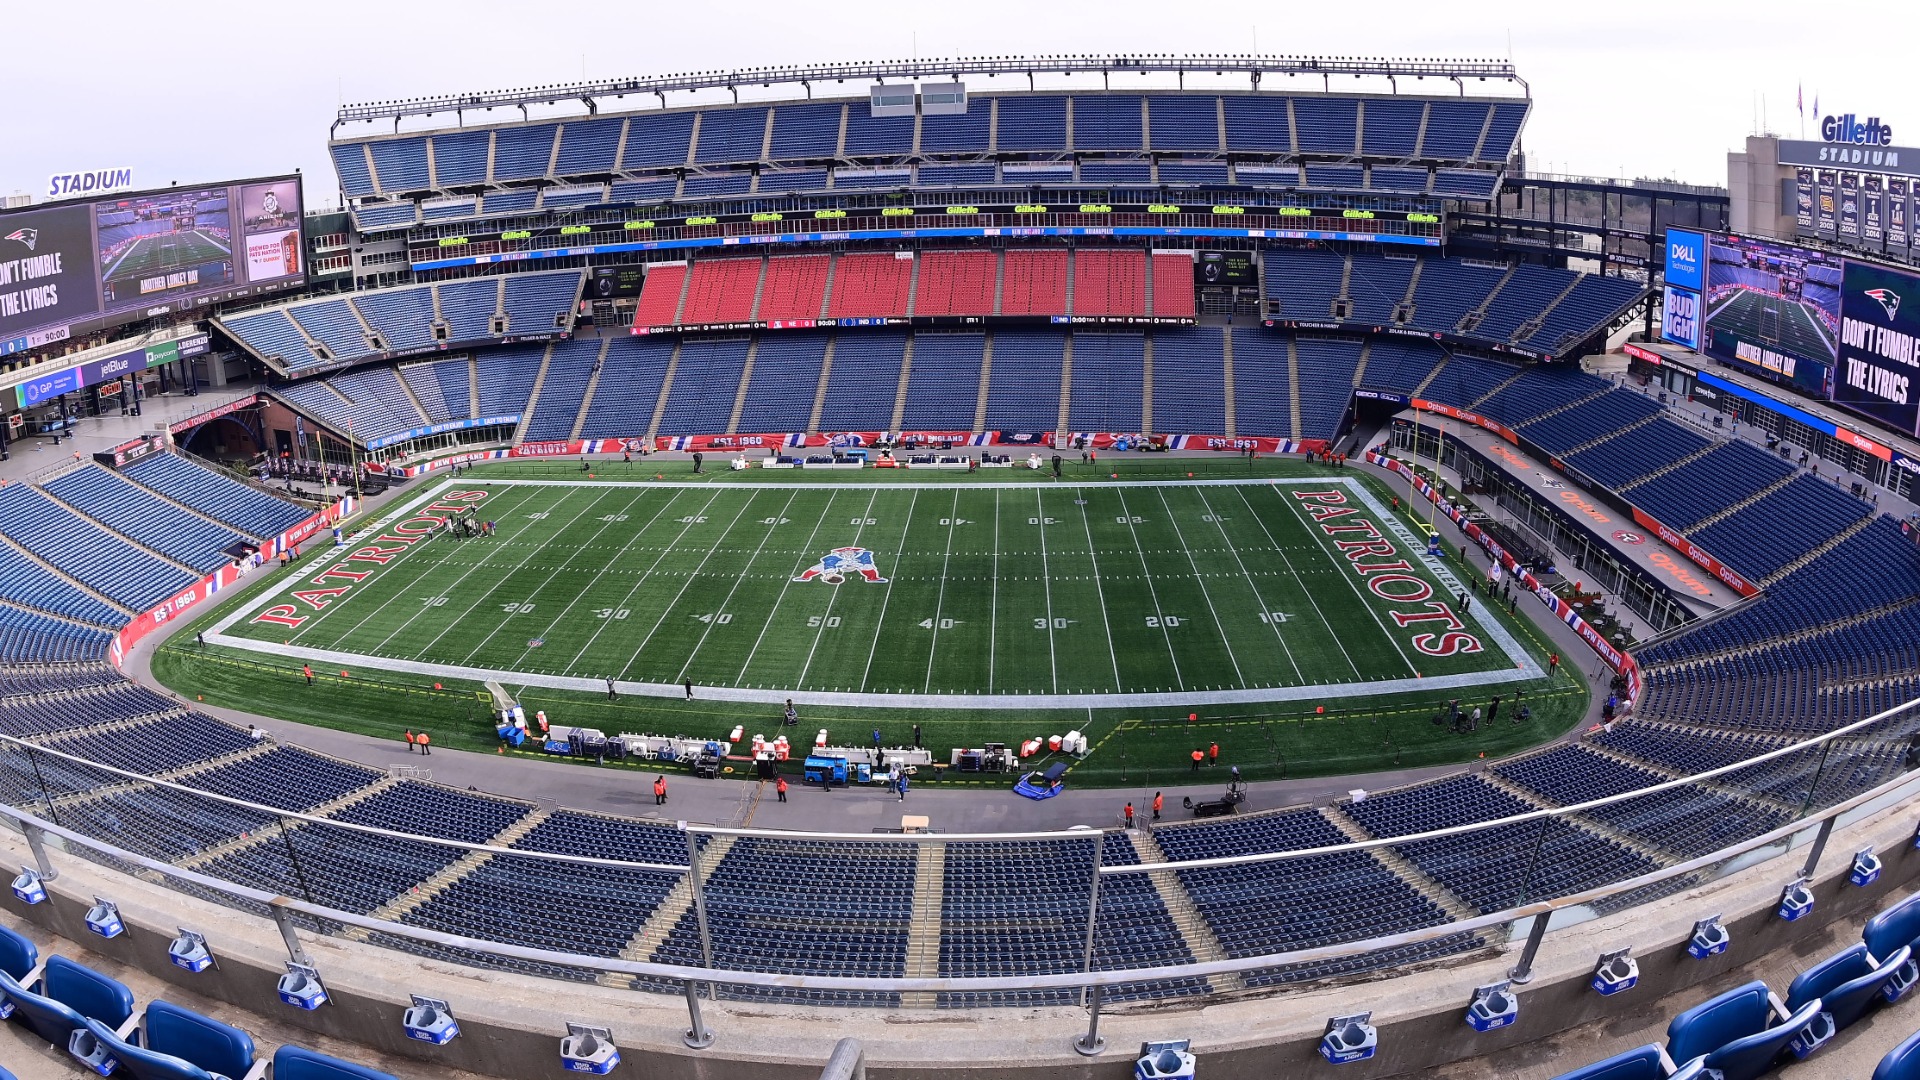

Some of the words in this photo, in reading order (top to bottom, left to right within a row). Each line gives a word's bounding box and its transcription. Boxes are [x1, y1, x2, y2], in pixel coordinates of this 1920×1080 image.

[1821, 114, 1893, 147] Gillette
[1819, 147, 1899, 168] STADIUM
[50, 168, 131, 196] STADIUM
[815, 209, 846, 219] Gillette
[882, 207, 914, 217] Gillette
[946, 205, 978, 215] Gillette
[1014, 205, 1047, 214] Gillette
[1079, 204, 1111, 214] Gillette
[1147, 205, 1180, 214] Gillette
[1213, 205, 1244, 215] Gillette
[1279, 207, 1311, 217] Gillette
[1343, 209, 1374, 219] Gillette
[686, 216, 717, 225] Gillette
[751, 212, 783, 222] Gillette
[1407, 213, 1438, 223] Gillette
[561, 224, 591, 235] Gillette
[624, 220, 655, 230] Gillette
[1819, 221, 1834, 230] 2003
[501, 230, 531, 240] Gillette
[1866, 229, 1880, 238] 2014
[438, 236, 468, 247] Gillette
[1672, 244, 1696, 263] DELL
[0, 259, 20, 286] ON'T
[21, 252, 63, 280] FUMBLE
[1672, 260, 1696, 274] Technologies
[187, 269, 199, 283] DAY
[0, 291, 20, 317] THE
[20, 283, 58, 313] LYRICS
[1669, 292, 1694, 318] BUD
[147, 305, 170, 317] Gillette
[1666, 315, 1695, 341] LIGHT
[45, 329, 66, 342] 90:00
[1842, 316, 1876, 352] DON'T
[1876, 327, 1920, 369] FUMBLE
[154, 349, 176, 361] paycom
[1624, 345, 1640, 357] TOYOTA
[1642, 351, 1659, 364] TOYOTA
[1736, 340, 1762, 363] ANOTHER
[1783, 355, 1797, 375] DAY
[101, 359, 128, 378] jetBlue
[1847, 357, 1868, 391] THE
[1868, 366, 1909, 405] LYRICS
[1356, 390, 1378, 398] GEICO
[1427, 401, 1448, 413] Optum
[170, 421, 190, 434] OYOTA
[191, 411, 212, 426] TOYOTA
[214, 402, 234, 418] TOYOTA
[235, 395, 256, 410] TOYOTA
[1456, 409, 1477, 422] Optum
[1483, 418, 1500, 432] Optum
[739, 434, 762, 444] 1960
[1854, 435, 1873, 450] Optum
[518, 443, 567, 455] PATRIOTS
[1560, 491, 1611, 523] Optum
[1394, 528, 1426, 552] CAUSE
[1658, 526, 1680, 547] Optum
[249, 490, 489, 629] PATRIOTS
[1688, 545, 1711, 568] Optum
[1292, 488, 1485, 657] PATRIOTS
[1650, 553, 1711, 595] Optum
[1719, 566, 1743, 590] Optum
[175, 589, 196, 610] 1960
[423, 596, 450, 607] 10
[504, 602, 536, 614] 20
[598, 608, 631, 620] 30
[699, 613, 733, 625] 40
[807, 616, 842, 628] 50
[918, 617, 954, 630] 40
[1034, 617, 1068, 630] 30
[1146, 615, 1180, 628] 20
[1258, 611, 1287, 624] 10
[1583, 626, 1597, 644] NEW
